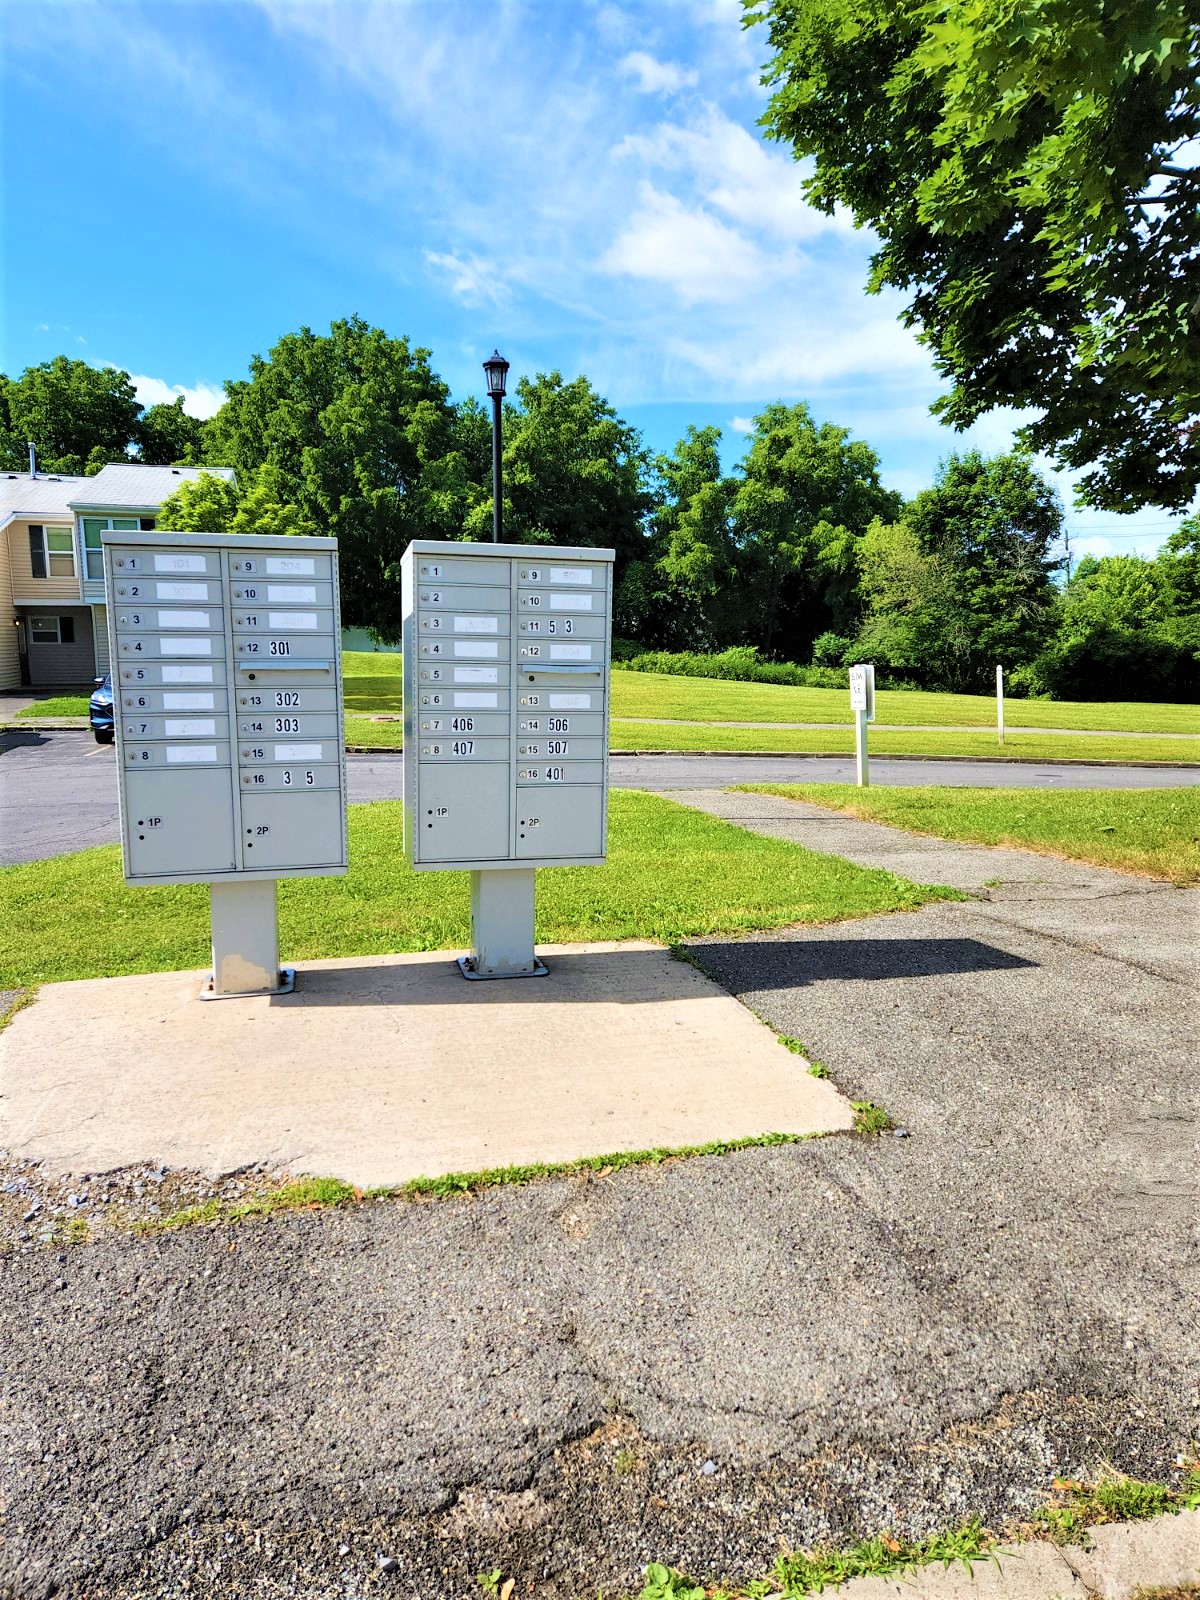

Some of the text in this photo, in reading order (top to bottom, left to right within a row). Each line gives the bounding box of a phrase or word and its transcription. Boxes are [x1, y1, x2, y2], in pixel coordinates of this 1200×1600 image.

[130, 559, 136, 568] 1
[245, 562, 252, 571] 9
[433, 567, 438, 576] 1
[531, 571, 537, 580] 9
[132, 587, 139, 596] 2
[244, 589, 256, 598] 10
[433, 593, 439, 602] 2
[529, 597, 540, 605] 10
[133, 615, 140, 624] 3
[246, 617, 257, 625] 11
[433, 619, 439, 627] 3
[529, 622, 539, 630] 11
[549, 620, 572, 633] 5 3
[135, 642, 142, 651] 4
[247, 644, 259, 652] 12
[270, 641, 290, 655] 301
[433, 645, 439, 653] 4
[529, 647, 539, 655] 12
[137, 670, 144, 679] 5
[433, 670, 439, 678] 5
[138, 697, 146, 706] 6
[249, 696, 261, 705] 13
[276, 692, 299, 706] 302
[434, 695, 440, 703] 6
[528, 696, 539, 705] 13
[140, 724, 147, 733] 7
[251, 723, 262, 731] 14
[275, 718, 299, 732] 303
[434, 721, 439, 729] 7
[452, 718, 473, 731] 406
[528, 721, 538, 730] 14
[548, 718, 568, 732] 506
[434, 746, 440, 754] 8
[453, 741, 474, 755] 407
[528, 746, 538, 754] 15
[548, 741, 567, 754] 507
[142, 751, 149, 760] 8
[252, 749, 264, 758] 15
[284, 771, 313, 785] 3 5
[527, 770, 538, 778] 16
[546, 767, 564, 780] 401
[253, 775, 265, 783] 16
[436, 807, 448, 816] 1P
[148, 818, 161, 827] 1P
[528, 818, 540, 827] 2P
[256, 826, 269, 835] 2P
